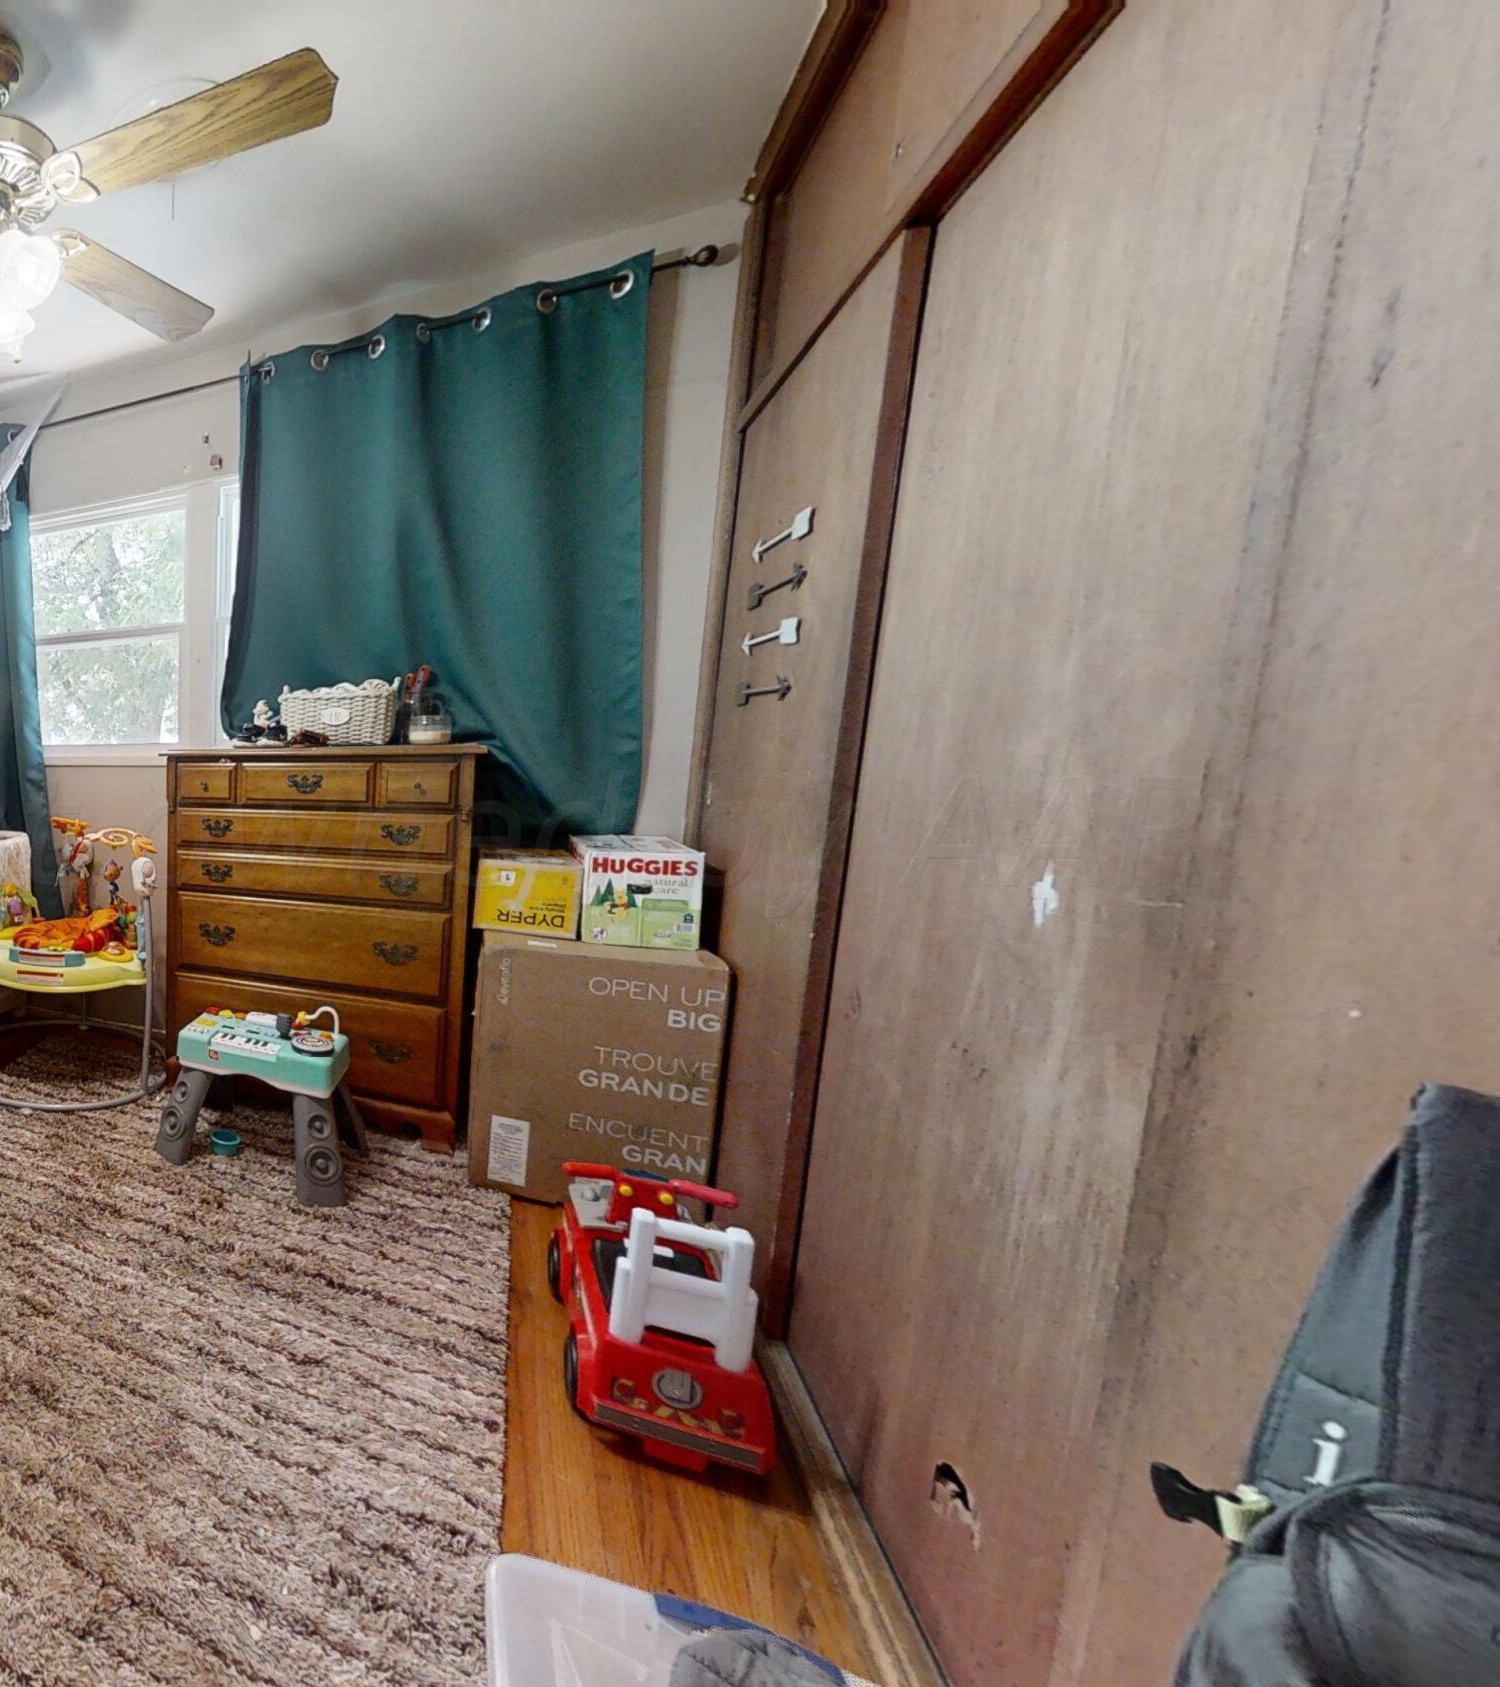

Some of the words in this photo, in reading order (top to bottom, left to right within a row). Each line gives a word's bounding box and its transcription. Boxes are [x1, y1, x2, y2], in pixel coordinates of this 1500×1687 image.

[591, 857, 698, 877] HUGGIES
[588, 976, 669, 1004] OPEN
[680, 986, 726, 1009] UP
[667, 1009, 722, 1033] BIG
[594, 1045, 718, 1084] TROUVE
[578, 1069, 711, 1107] GRANDE
[568, 1112, 710, 1151] ENCUENT
[621, 1144, 707, 1177] GRAN
